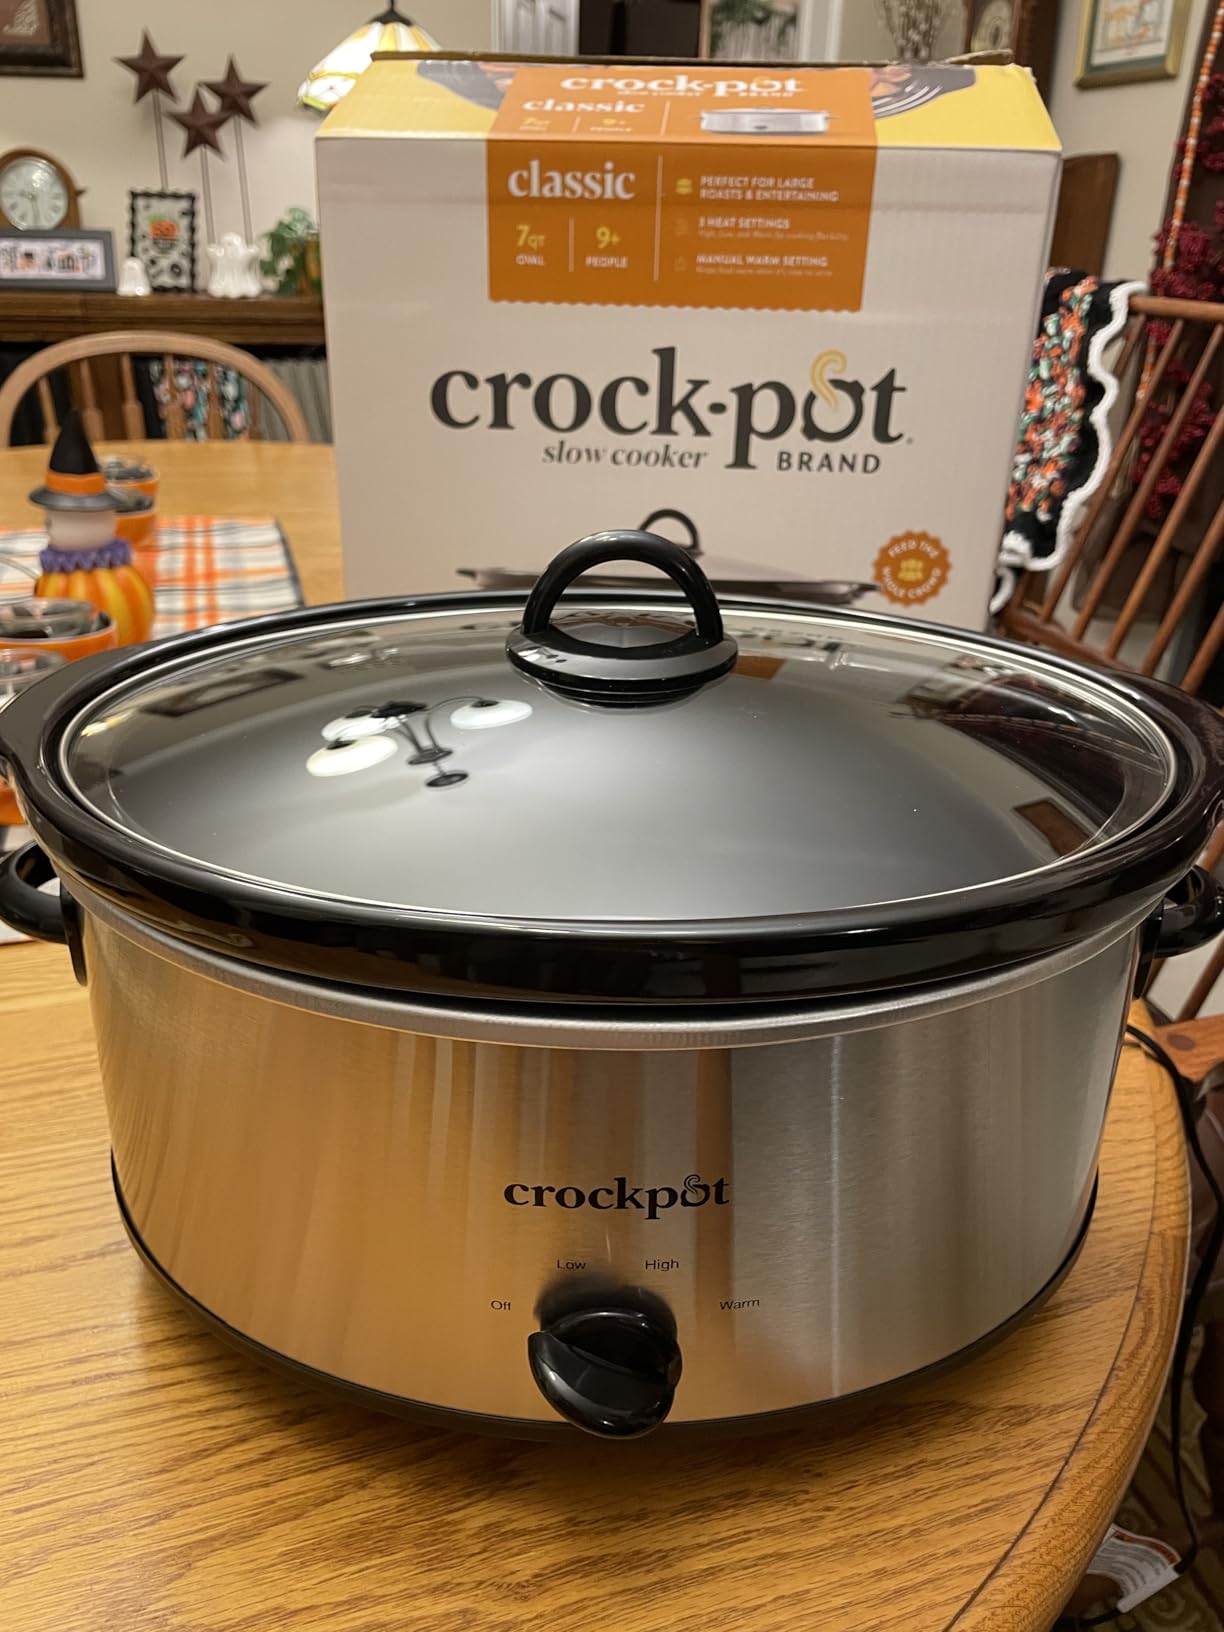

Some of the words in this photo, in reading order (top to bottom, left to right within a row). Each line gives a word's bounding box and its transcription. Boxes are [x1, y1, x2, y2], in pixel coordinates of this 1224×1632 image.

[523, 98, 646, 112] classic
[507, 160, 636, 199] classic
[701, 176, 749, 188] PERFECT
[752, 177, 775, 188] FOR
[777, 177, 815, 189] LARGE
[701, 189, 742, 200] ROASTS
[756, 190, 839, 202] ENTERTAINING
[707, 217, 736, 228] HEAT
[738, 218, 790, 230] SETTINGS
[596, 226, 621, 249] 9+
[585, 256, 628, 269] PEOPLE
[696, 255, 743, 266] MANUAL
[746, 256, 780, 267] WARM
[783, 256, 828, 268] SETTING
[542, 439, 605, 465] slow
[611, 444, 710, 469] cooker
[777, 451, 881, 474] BRAND
[504, 1174, 731, 1220] crockpot
[556, 1259, 587, 1271] Low
[645, 1259, 680, 1272] High
[490, 1299, 512, 1311] Off
[719, 1298, 761, 1311] Warm
